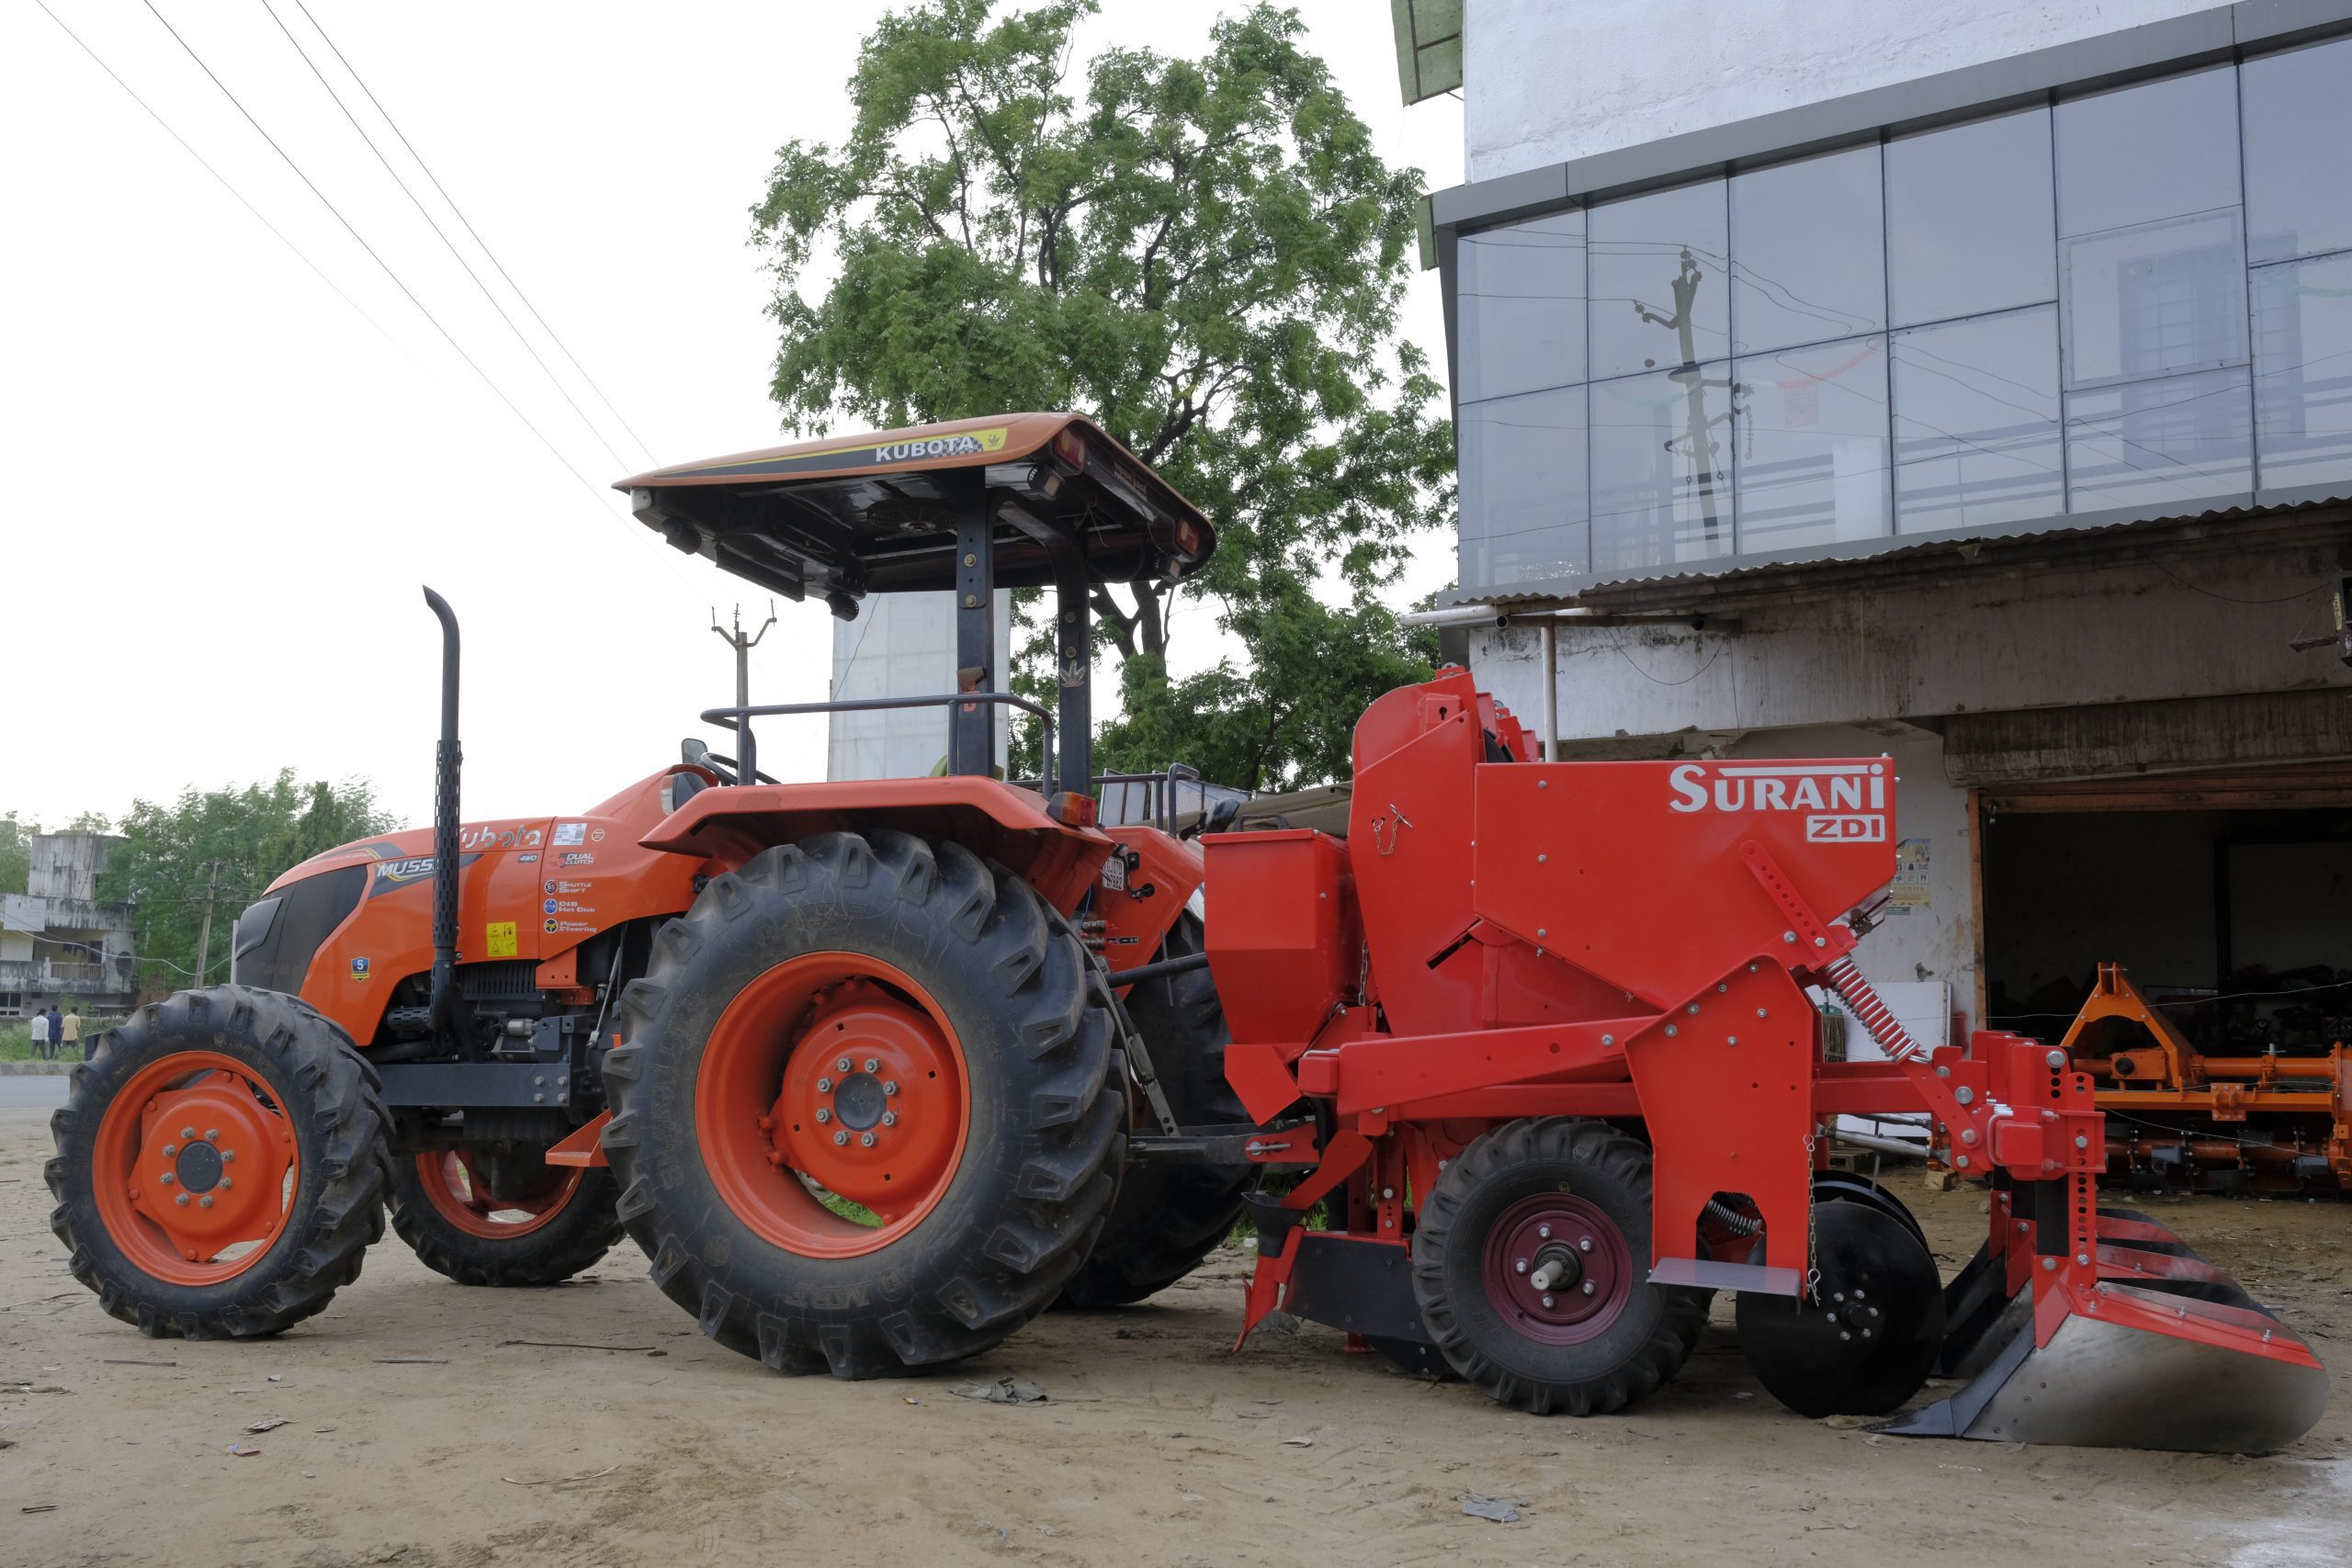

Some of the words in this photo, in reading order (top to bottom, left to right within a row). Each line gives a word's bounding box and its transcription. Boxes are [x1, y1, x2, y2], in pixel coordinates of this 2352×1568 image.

[876, 435, 975, 462] KUBOTA
[1812, 818, 1881, 838] ZDI
[356, 959, 364, 970] 5
